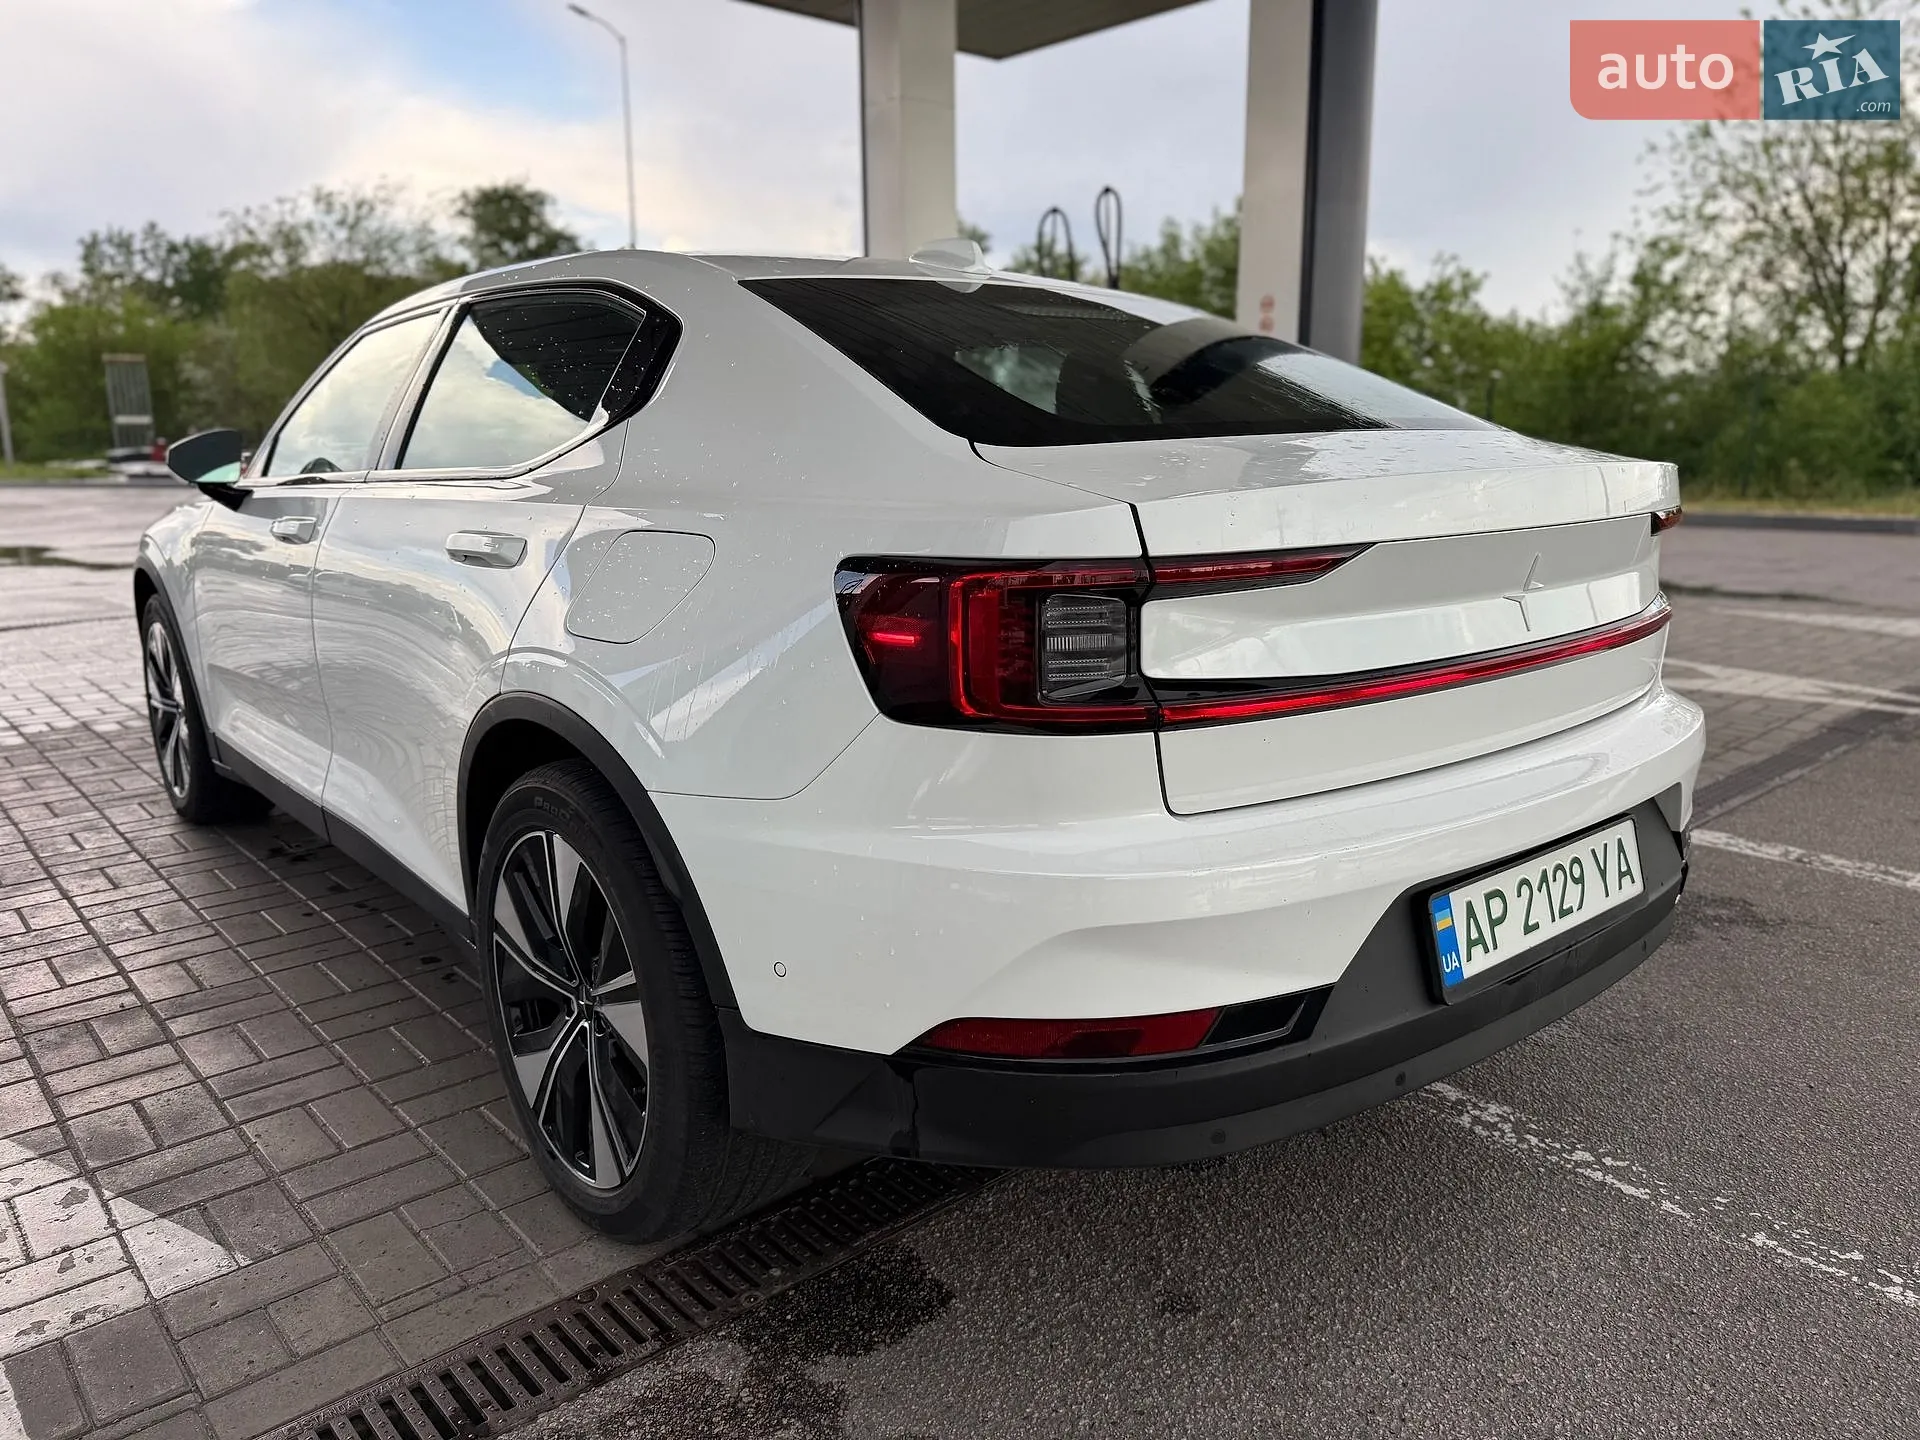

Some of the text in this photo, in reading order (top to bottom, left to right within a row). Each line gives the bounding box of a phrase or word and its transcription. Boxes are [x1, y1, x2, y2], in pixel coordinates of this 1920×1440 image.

[1465, 836, 1636, 963] AP 2129 YA
[1442, 953, 1462, 973] UA
